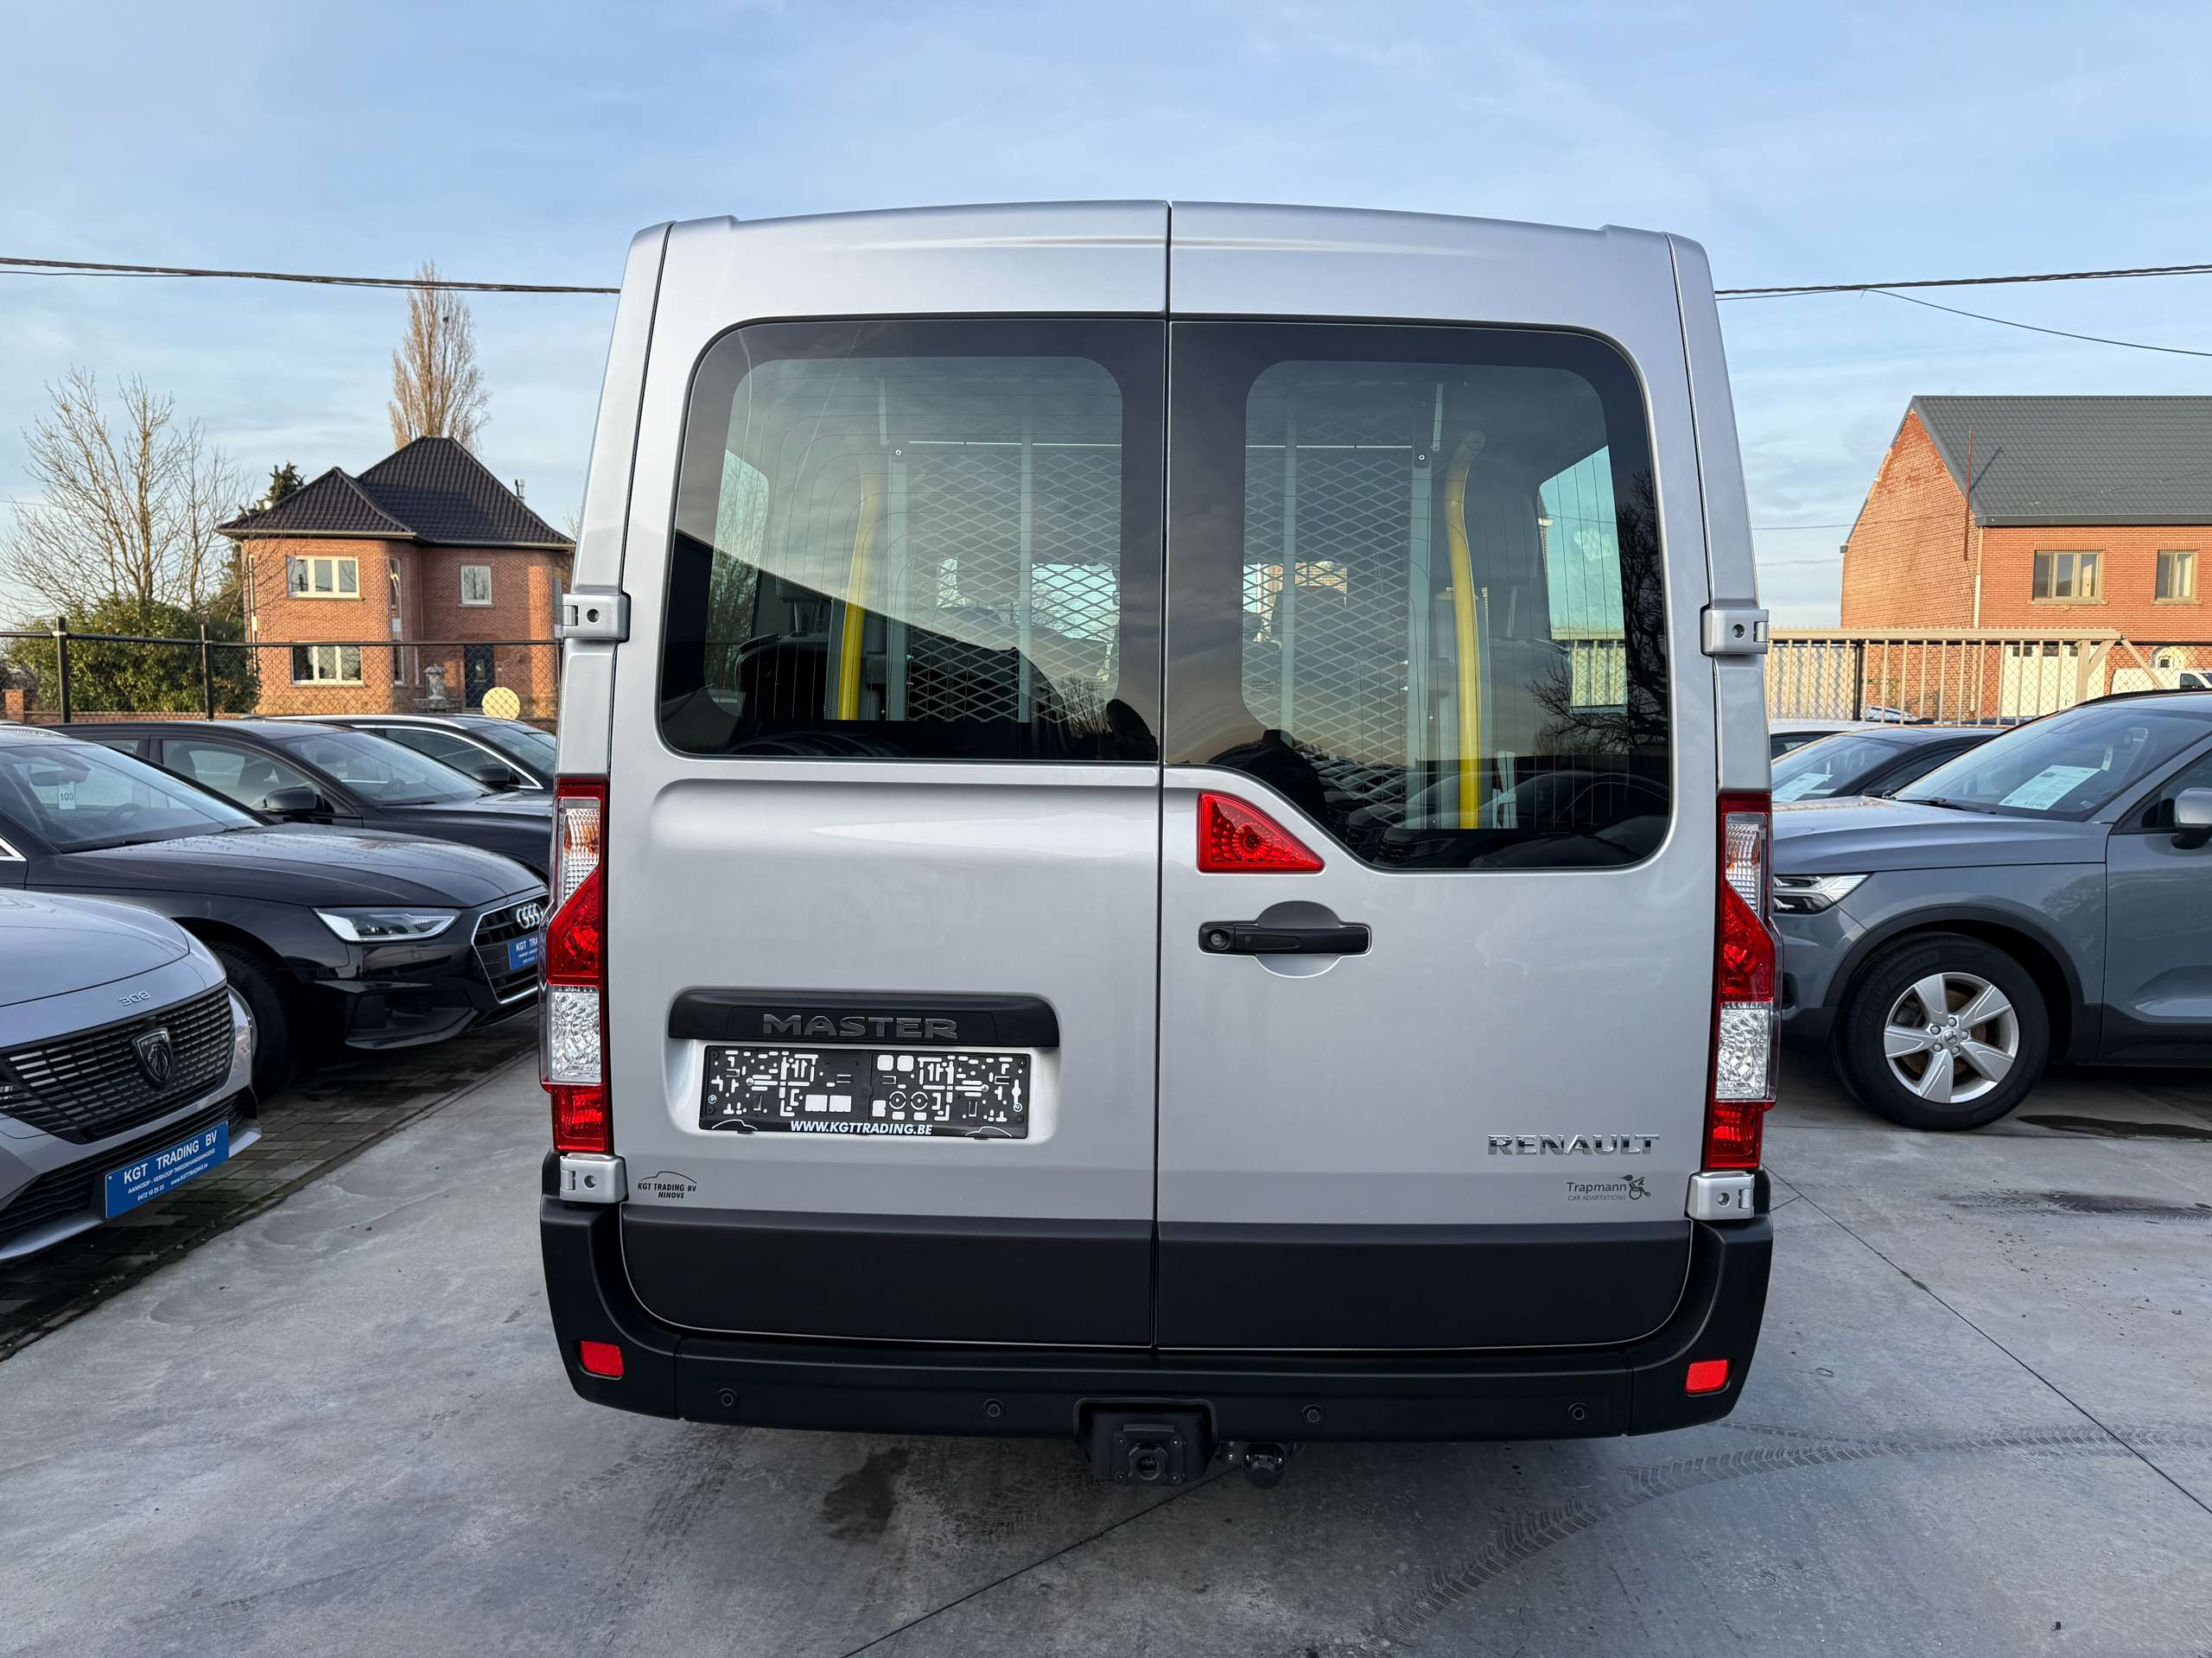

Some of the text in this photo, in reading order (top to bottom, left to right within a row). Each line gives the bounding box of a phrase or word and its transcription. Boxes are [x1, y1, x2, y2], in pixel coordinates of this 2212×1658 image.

[60, 792, 74, 801] 103
[516, 940, 526, 952] KGT
[118, 990, 151, 1006] 308
[763, 1013, 959, 1039] MASTER
[791, 1121, 933, 1135] WWW.KGTTRADING.BE
[1486, 1134, 1660, 1155] RENAULT
[124, 1129, 218, 1185] KGT TRADING BV
[638, 1182, 652, 1191] KGT
[653, 1183, 685, 1191] TRADING
[1566, 1181, 1627, 1194] Trapmann
